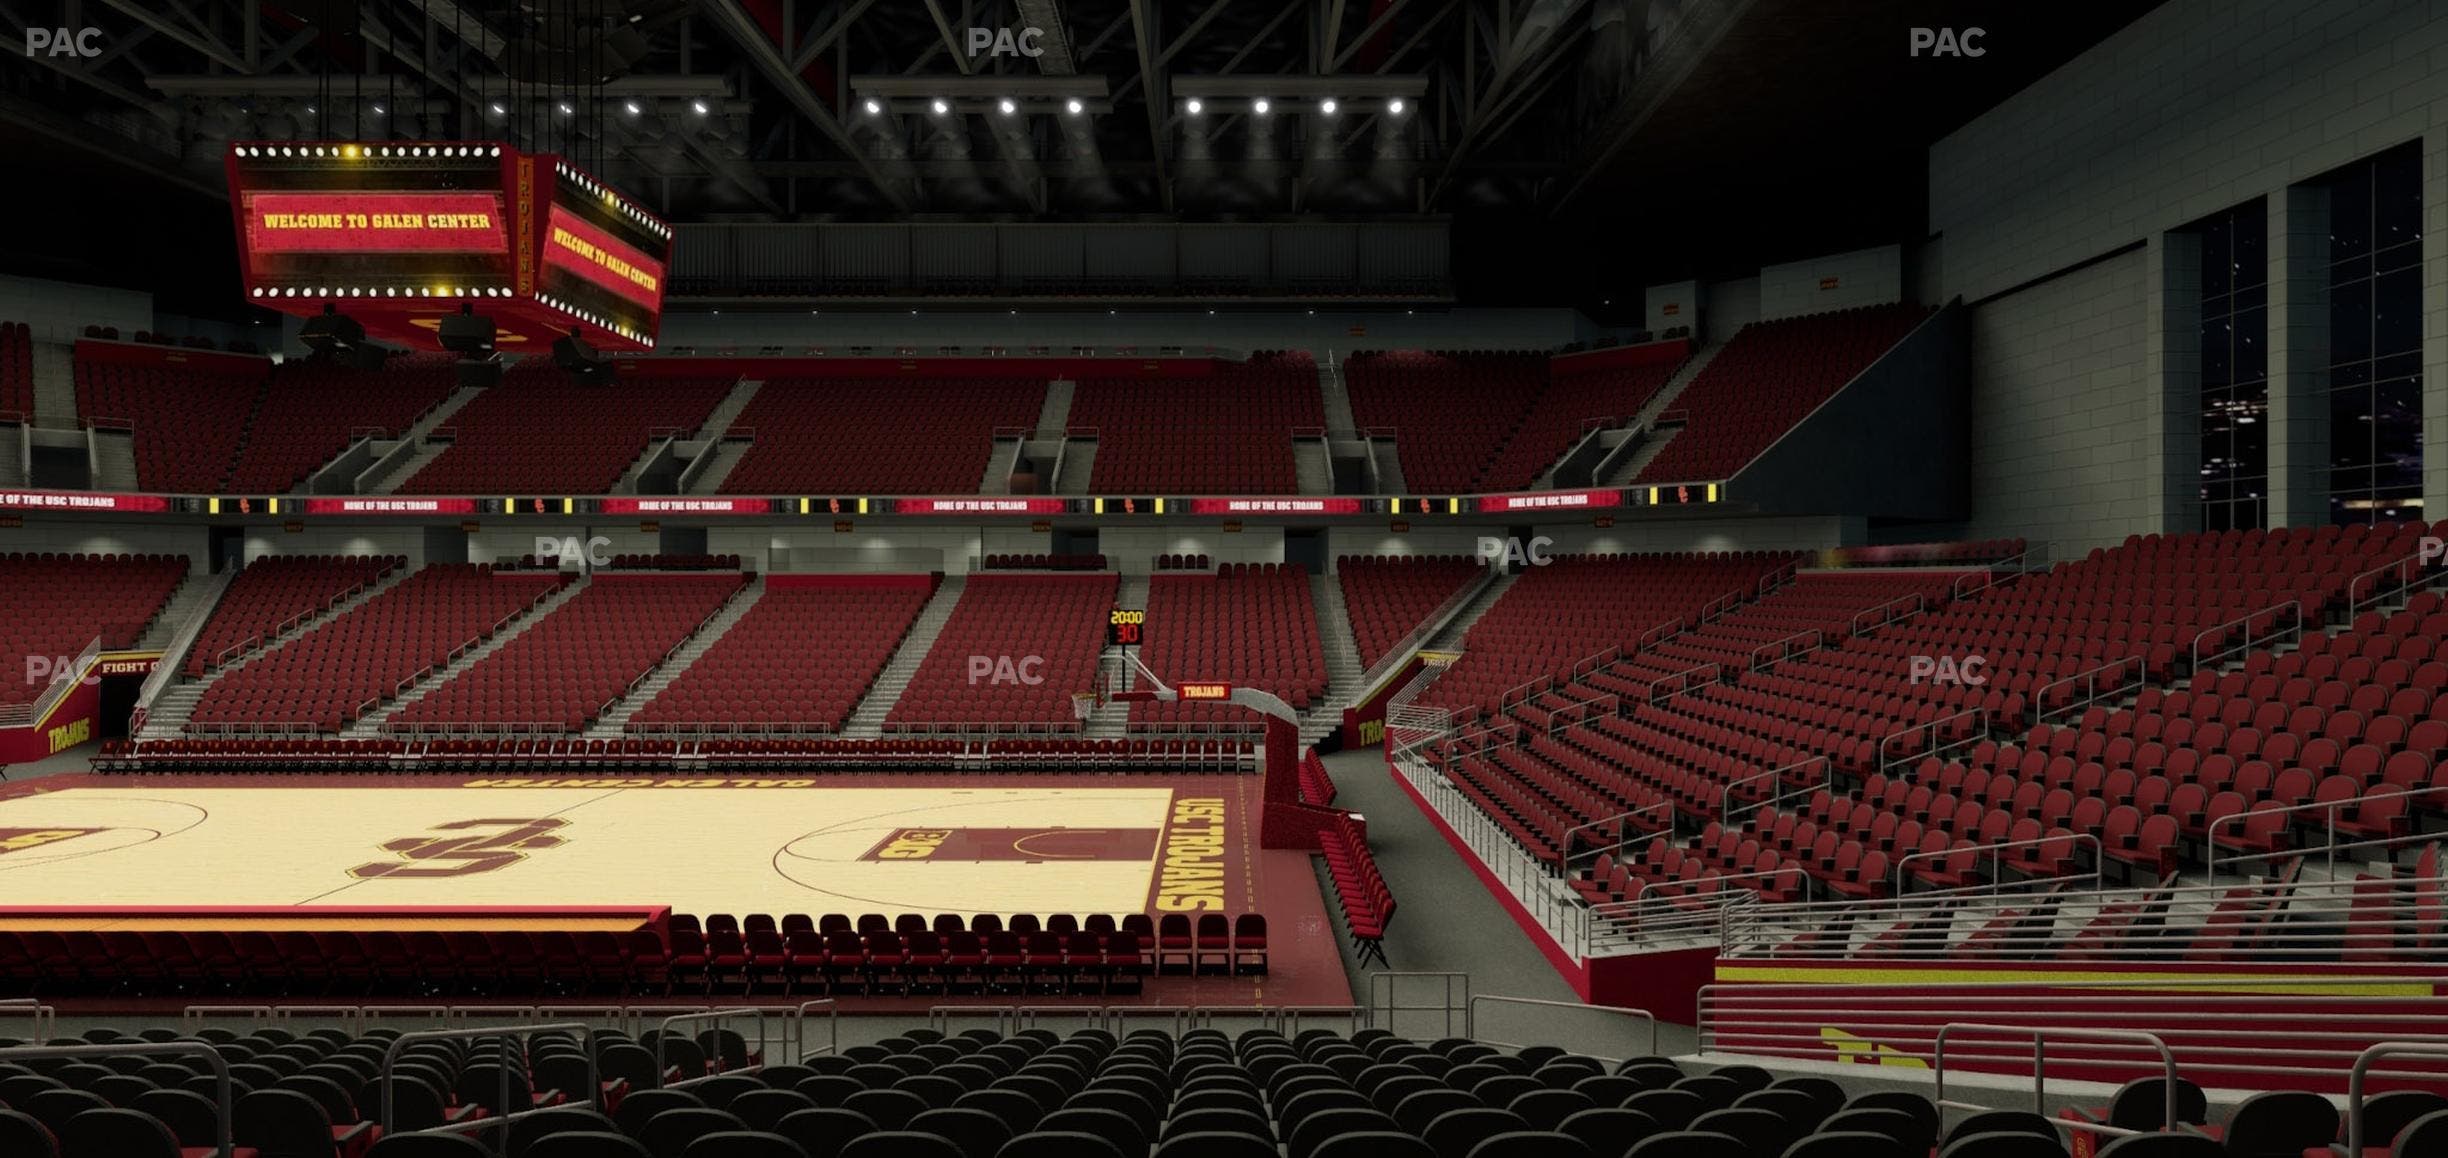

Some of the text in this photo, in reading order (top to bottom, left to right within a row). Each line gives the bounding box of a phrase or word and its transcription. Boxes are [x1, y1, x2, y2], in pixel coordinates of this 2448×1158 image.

[263, 214, 491, 229] WELCOME TO GALEN CENTER
[553, 227, 657, 292] WELCOME TO GALEN CENTER
[5, 494, 20, 504] OF
[22, 495, 44, 505] THE
[45, 495, 67, 506] USC
[68, 496, 115, 507] TROJANS
[344, 501, 365, 510] HOME
[366, 501, 375, 510] OF
[376, 501, 390, 510] THE
[406, 501, 438, 510] TROJANS
[638, 501, 659, 510] HOME
[660, 501, 669, 510] OF
[671, 501, 685, 510] THE
[701, 501, 733, 510] TROJANS
[933, 501, 954, 510] HOME
[955, 501, 965, 510] OF
[966, 501, 979, 510] THE
[996, 501, 1027, 510] TROJANS
[1229, 501, 1250, 510] HOME
[1251, 501, 1261, 510] OF
[1262, 501, 1276, 510] THE
[1292, 501, 1323, 510] TROJANS
[1508, 497, 1526, 508] HOME
[1526, 497, 1534, 507] OF
[1535, 496, 1546, 507] THE
[1560, 494, 1588, 505] TROJANS
[1110, 611, 1143, 624] 20:00
[1117, 625, 1138, 643] 30
[101, 662, 147, 674] FIGHT
[1183, 686, 1225, 698] TROJANS
[47, 716, 91, 754] TROJANS
[1156, 798, 1225, 911] USC TROJANS
